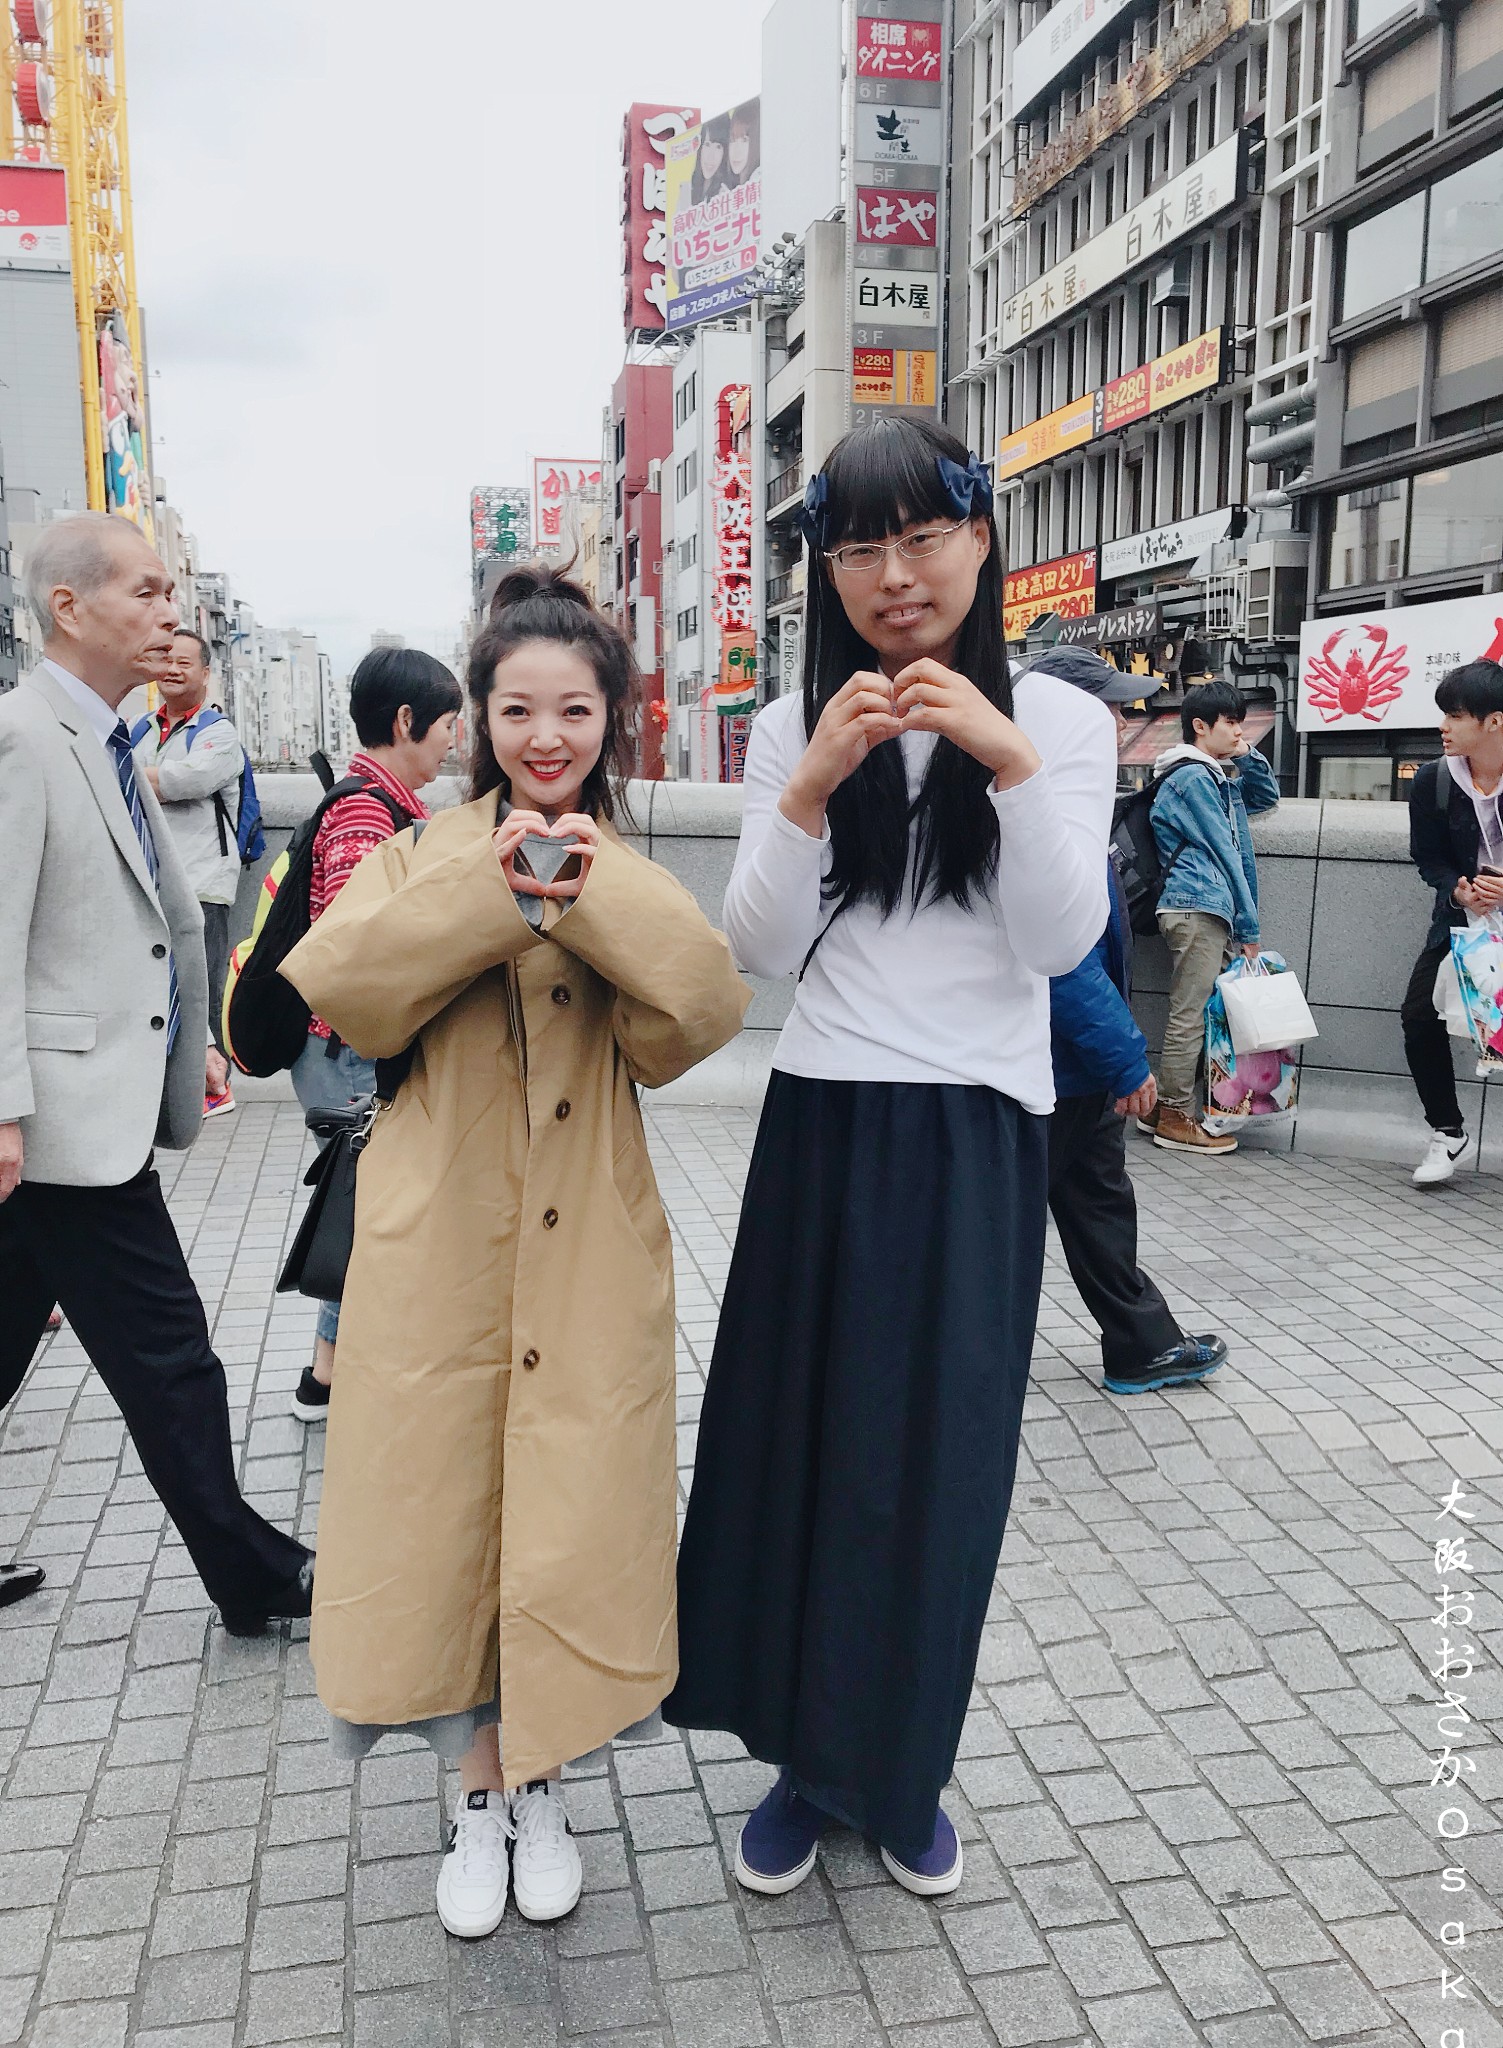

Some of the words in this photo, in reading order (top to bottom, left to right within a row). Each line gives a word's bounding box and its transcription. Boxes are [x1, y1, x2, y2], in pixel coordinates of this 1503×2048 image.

[870, 22, 907, 46] 相席
[858, 46, 940, 76] ダイニング
[860, 82, 887, 99] 6F
[874, 167, 895, 183] 5F
[673, 182, 761, 237] 高収入お仕事情
[858, 195, 936, 241] はや
[1006, 300, 1017, 323] 4F
[1021, 264, 1078, 336] 白木屋
[1126, 172, 1204, 265] 白木屋
[859, 277, 931, 310] 白木屋
[857, 329, 884, 345] 3F
[1095, 390, 1104, 433] 3F
[710, 451, 751, 628] 大阪王将
[1084, 551, 1096, 570] 2F
[1058, 609, 1156, 642] ハンバーグレストラン
[784, 638, 795, 670] ZERO
[1426, 651, 1461, 666] 本場の味
